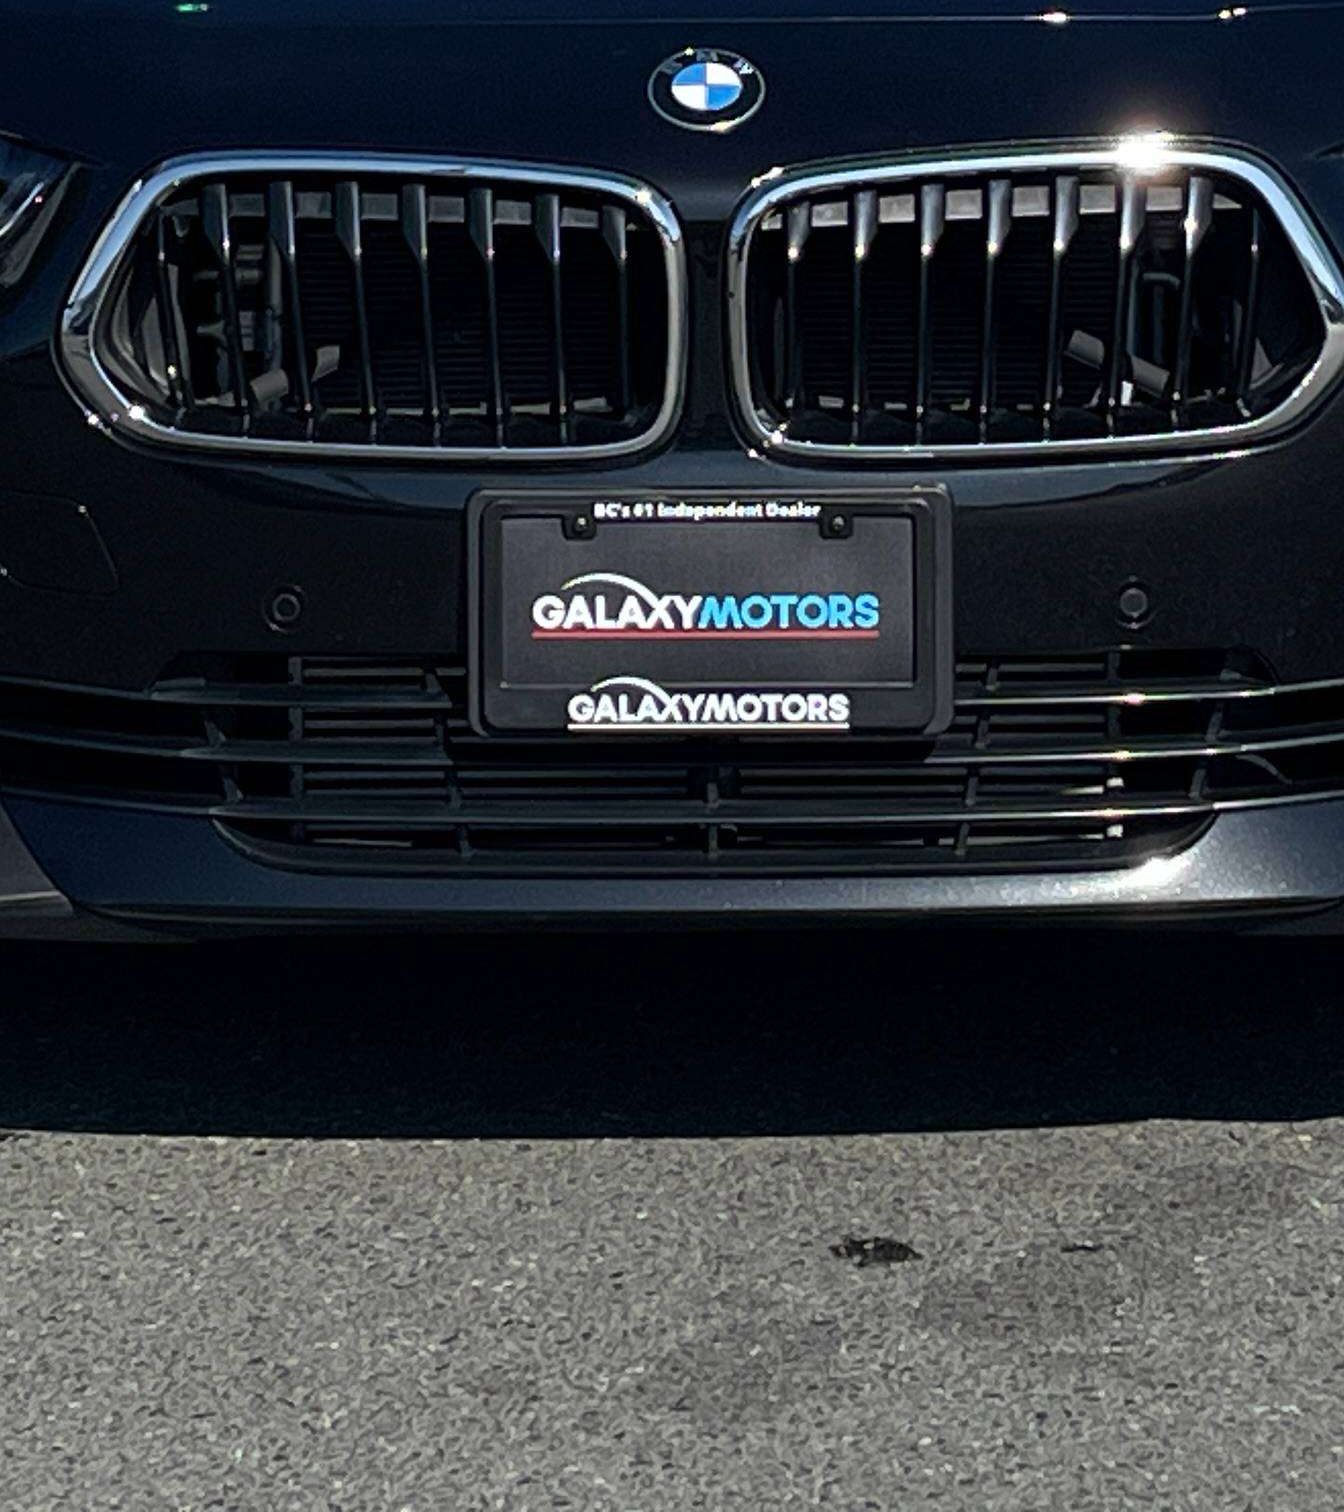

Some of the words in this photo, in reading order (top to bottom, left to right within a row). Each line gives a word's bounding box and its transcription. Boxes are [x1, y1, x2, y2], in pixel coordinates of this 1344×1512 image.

[657, 501, 763, 521] Independent
[765, 501, 822, 518] Dealer
[532, 594, 880, 630] GALAXYMOTORS
[567, 693, 850, 723] GALAXYMOTORS
